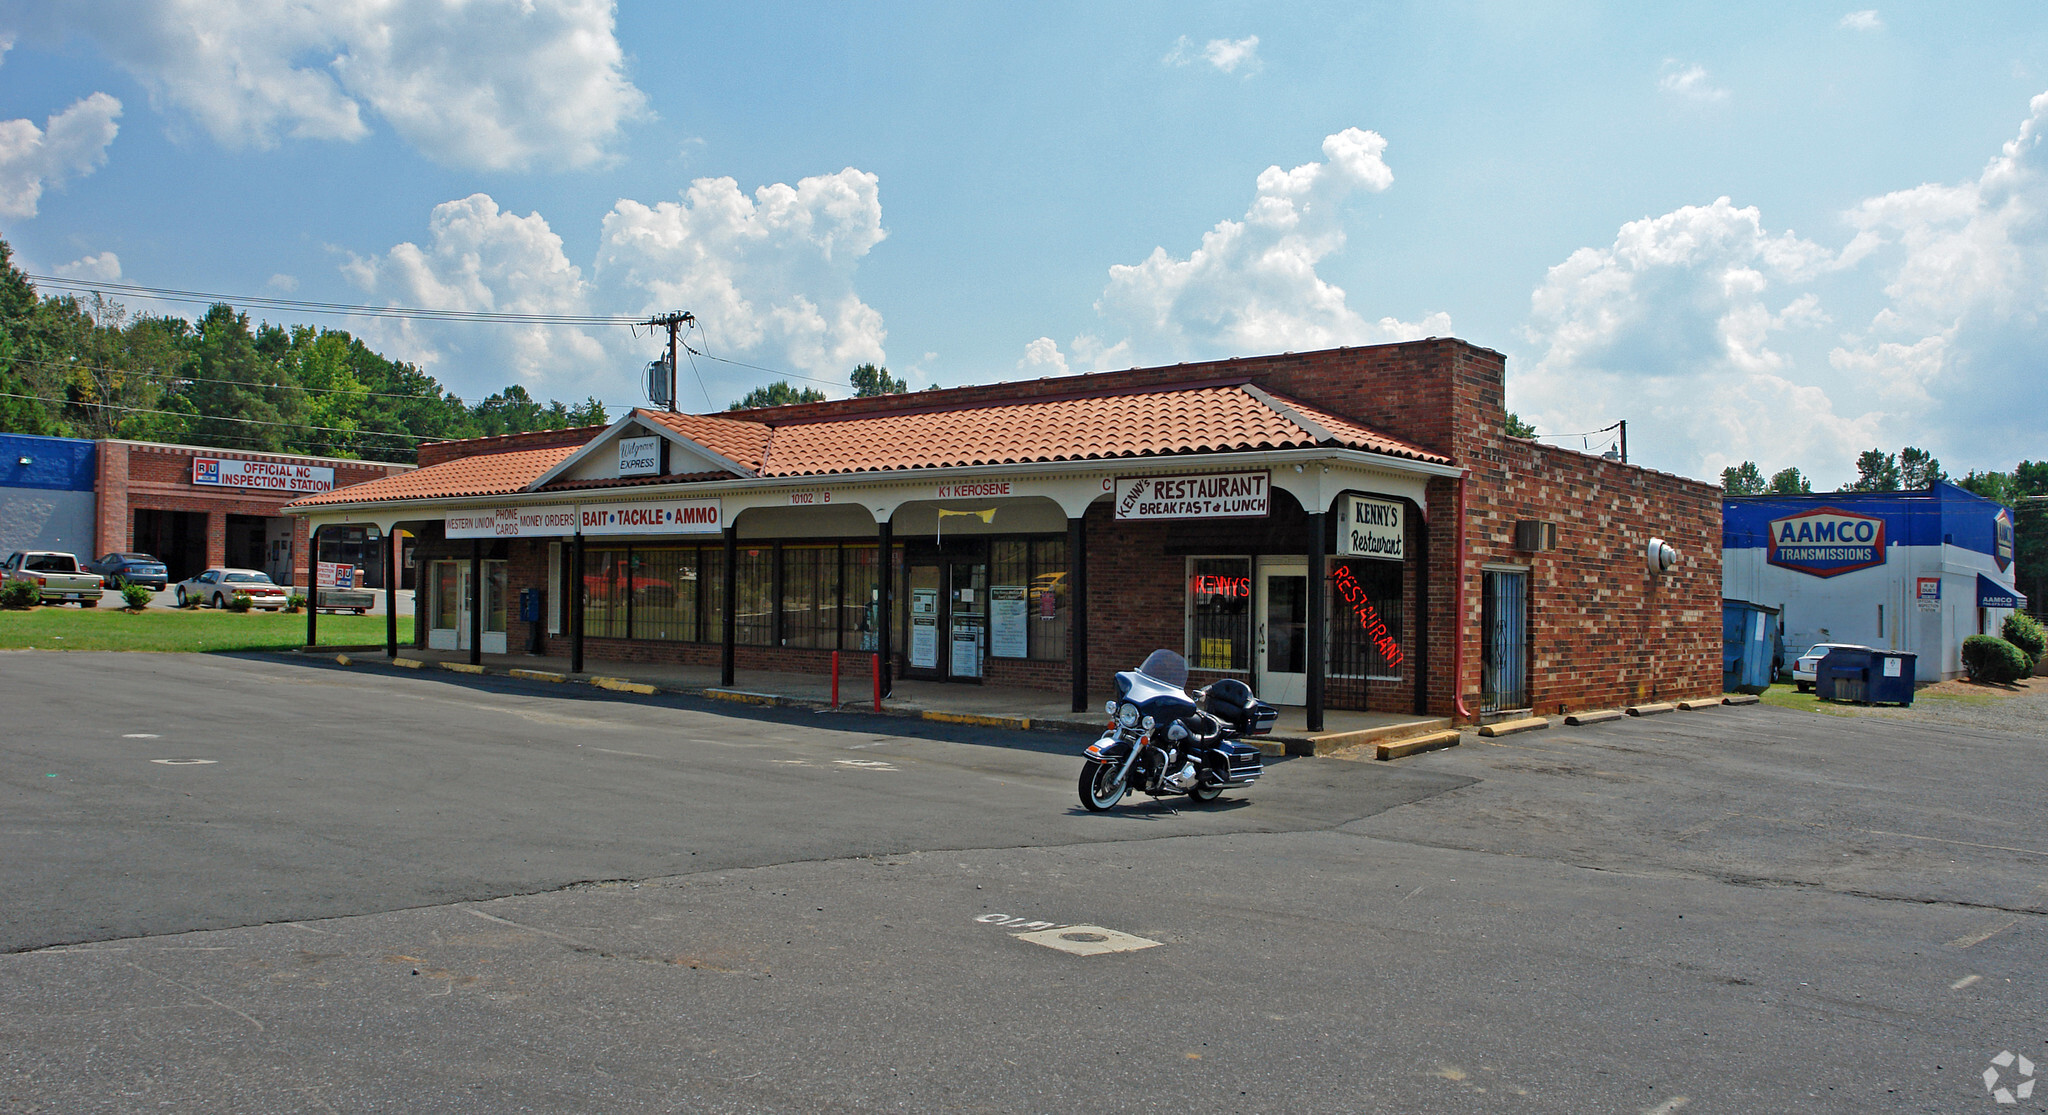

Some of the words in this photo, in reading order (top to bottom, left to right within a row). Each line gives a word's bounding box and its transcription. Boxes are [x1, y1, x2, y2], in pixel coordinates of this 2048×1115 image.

[198, 464, 205, 472] R
[209, 465, 216, 473] U
[243, 462, 292, 477] OFFICIAL
[296, 467, 311, 479] NC
[620, 458, 655, 470] EXPRESS
[221, 473, 286, 488] INSPECTION
[290, 478, 331, 492] STATION
[1102, 478, 1111, 491] C
[1154, 475, 1266, 500] RESTAURANT
[791, 493, 813, 504] 10102
[823, 491, 831, 503] B
[938, 485, 951, 498] K1
[953, 483, 1010, 497] KEROSENE
[1139, 501, 1212, 515] BREAKFAST
[1223, 498, 1266, 513] LUNCH
[495, 508, 518, 521] PHONE
[520, 515, 543, 527] MONEY
[544, 513, 575, 527] ORDERS
[582, 511, 608, 527] BAIT
[617, 508, 664, 526] TACKLE
[674, 506, 718, 525] AMMO
[1355, 501, 1398, 528] KENNY'S
[447, 518, 474, 530] WESTERN
[474, 516, 495, 529] UNION
[495, 523, 519, 536] CARDS
[1779, 521, 1874, 543] AAMCO
[1351, 529, 1402, 556] Restaurant
[1780, 548, 1871, 561] TRANSMISSIONS
[345, 570, 351, 578] U
[1195, 575, 1250, 597] KENNYS
[1334, 565, 1404, 668] RESTAURANT
